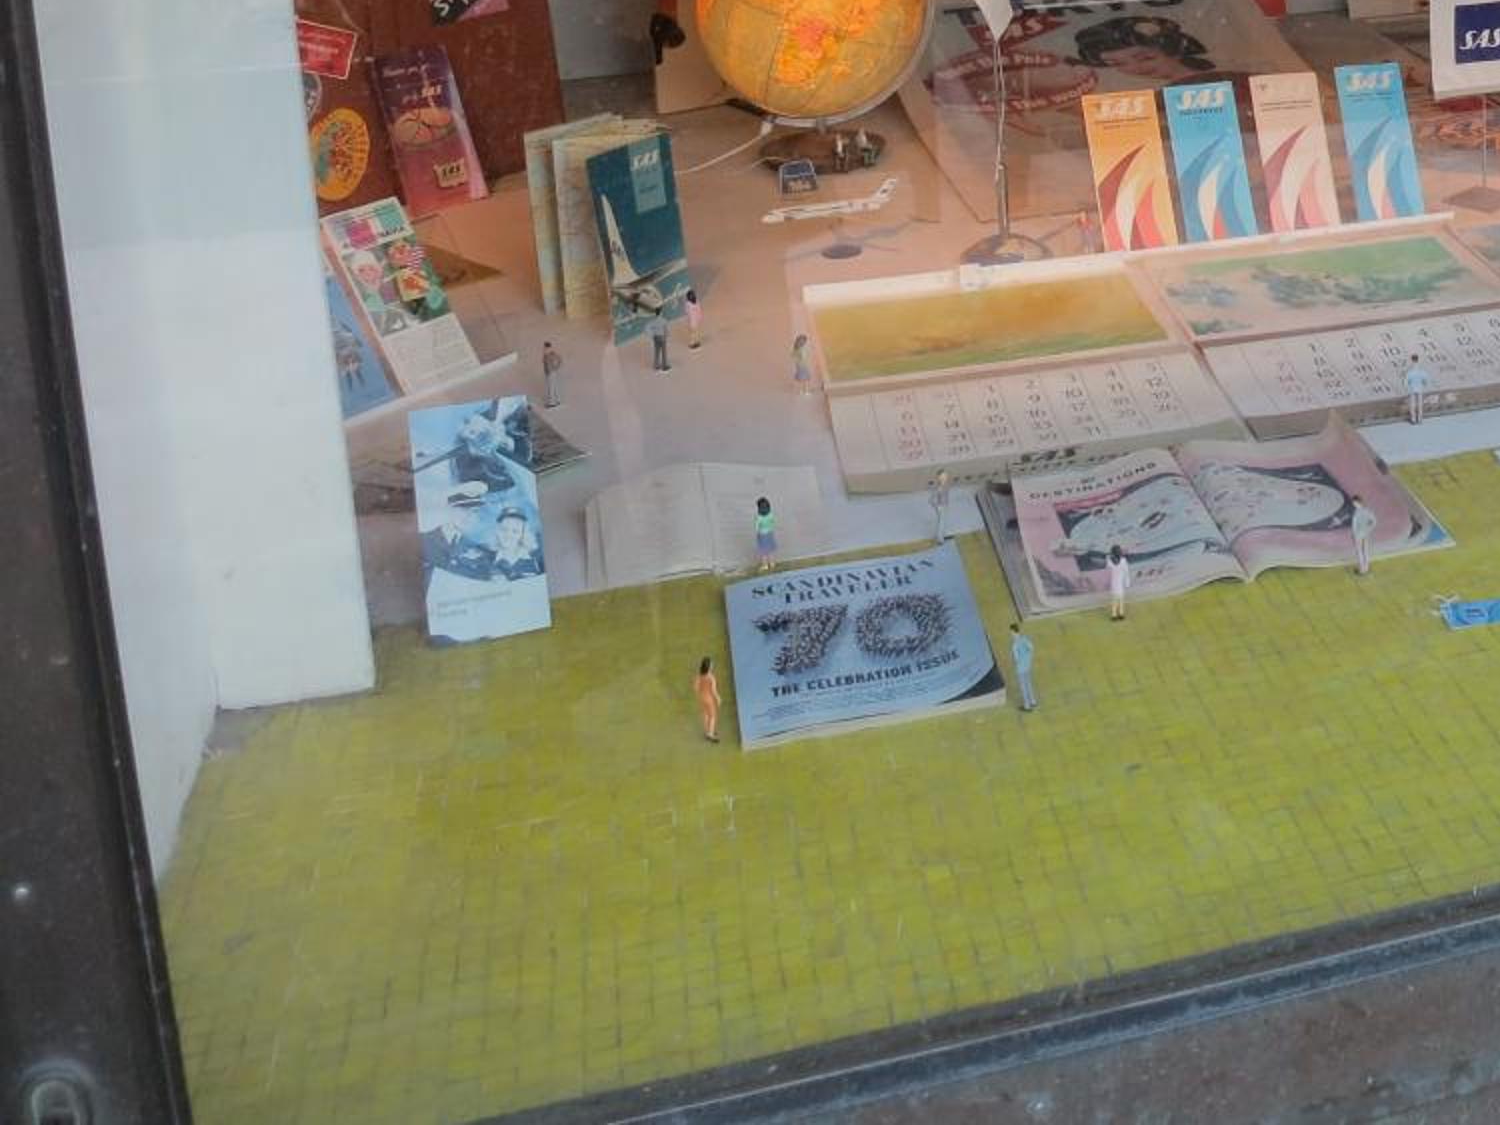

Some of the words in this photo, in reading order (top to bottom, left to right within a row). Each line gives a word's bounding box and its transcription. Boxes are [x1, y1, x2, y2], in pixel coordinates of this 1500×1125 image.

[1344, 72, 1392, 91] SAS
[1096, 97, 1147, 118] SAS
[1177, 89, 1226, 110] SAS
[632, 150, 660, 171] SAS
[1030, 461, 1158, 499] DESTINATIONS
[751, 559, 935, 599] SCANDINAVIAN
[784, 575, 912, 604] TRAVELER
[751, 594, 955, 676] 70
[771, 681, 800, 698] THE
[806, 663, 912, 692] CELEBRATION
[916, 649, 961, 672] ISSUE
